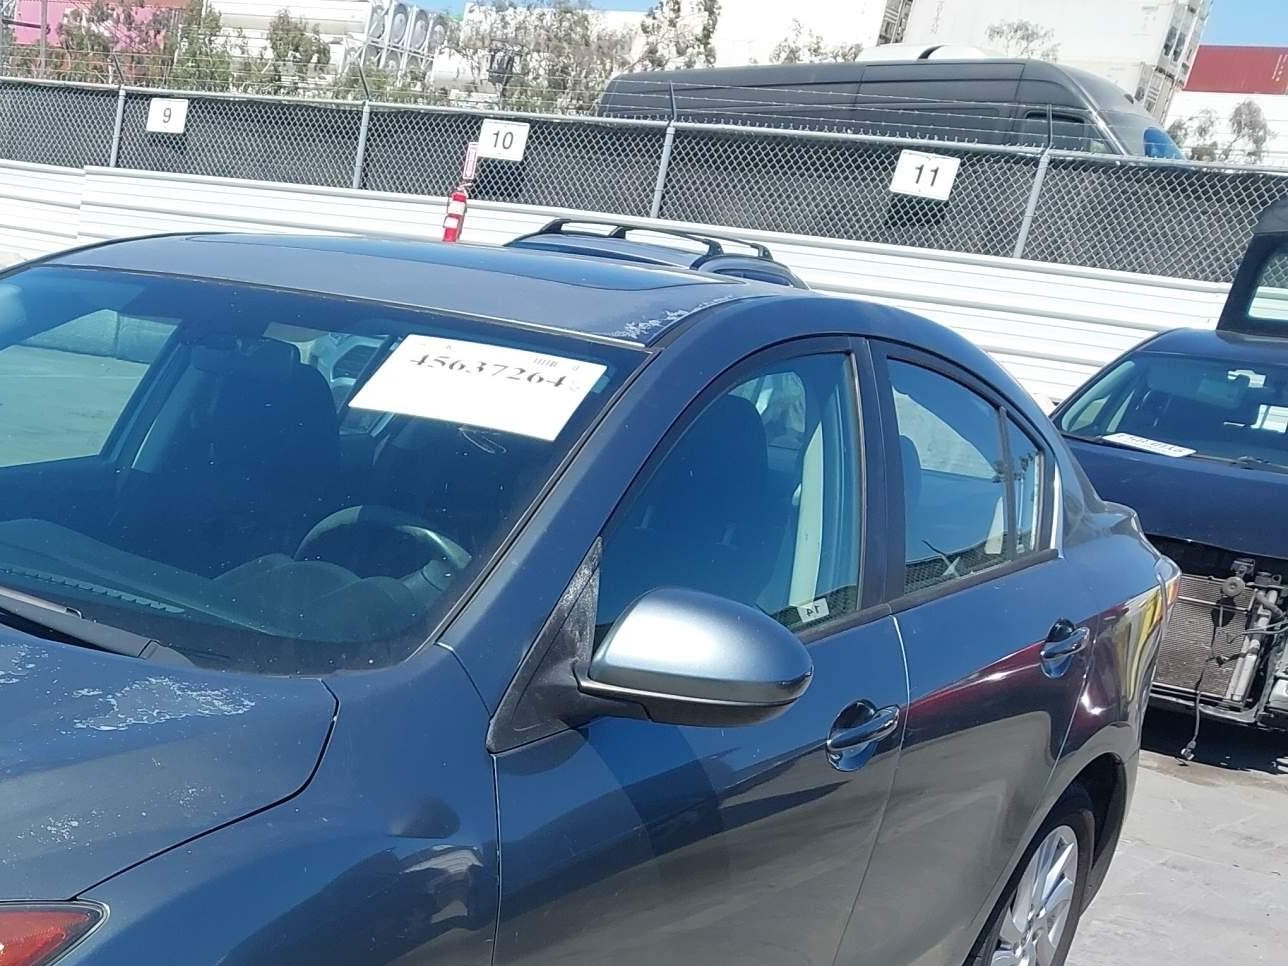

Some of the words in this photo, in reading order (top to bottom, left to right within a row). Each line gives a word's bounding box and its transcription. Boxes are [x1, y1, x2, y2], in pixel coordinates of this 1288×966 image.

[162, 107, 172, 124] 9
[492, 129, 515, 150] 10
[915, 163, 940, 188] 11
[409, 353, 568, 388] 45637264
